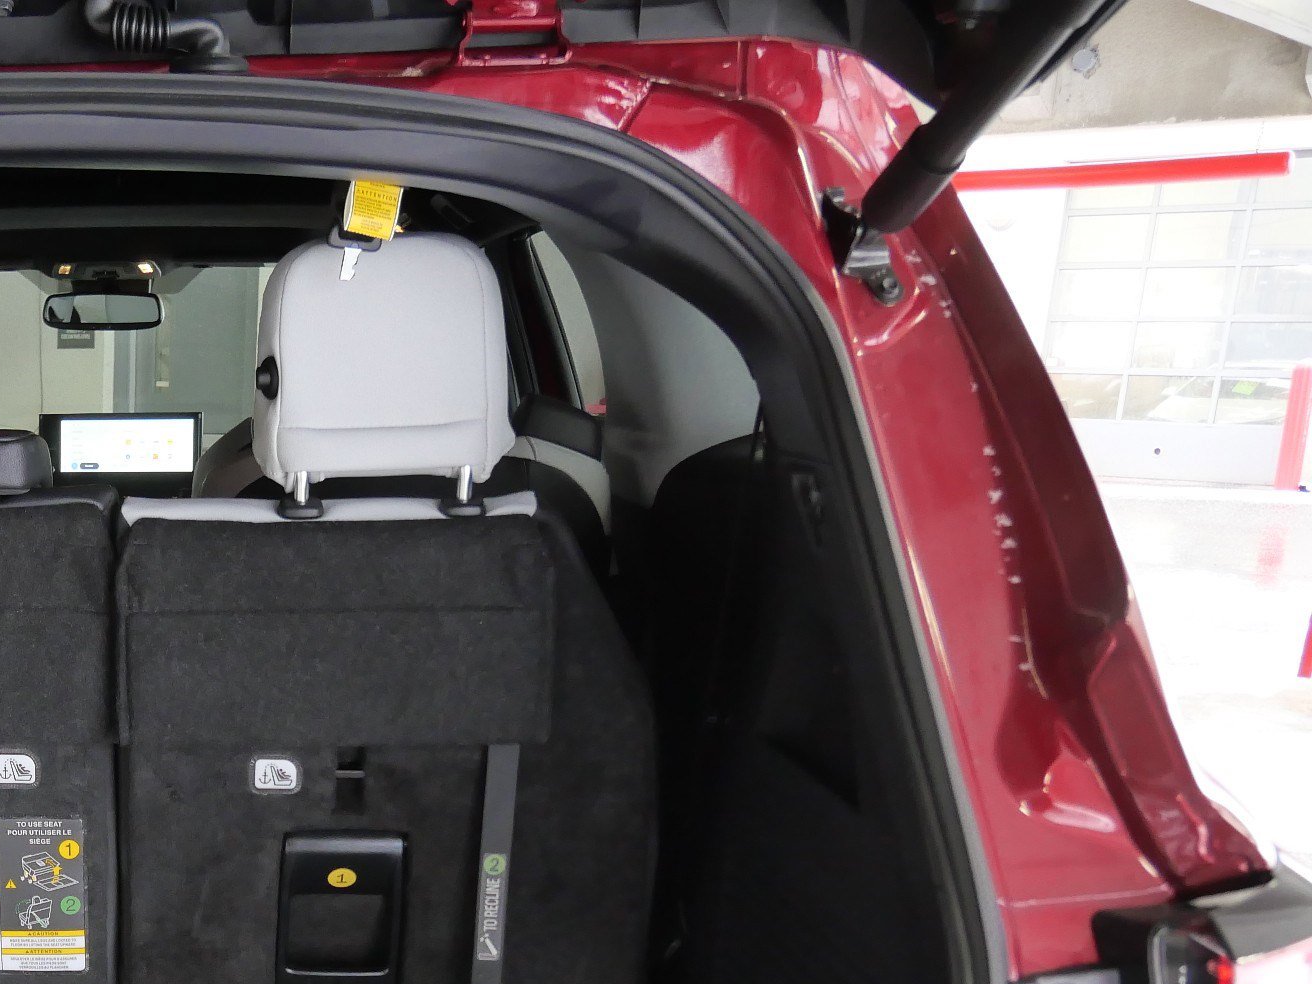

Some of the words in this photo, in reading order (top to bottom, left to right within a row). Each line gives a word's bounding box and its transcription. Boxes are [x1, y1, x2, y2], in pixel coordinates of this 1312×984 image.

[489, 857, 499, 872] 2
[336, 873, 348, 884] 1
[484, 877, 501, 918] RECLINE
[65, 898, 76, 912] 2
[483, 919, 497, 932] TO
